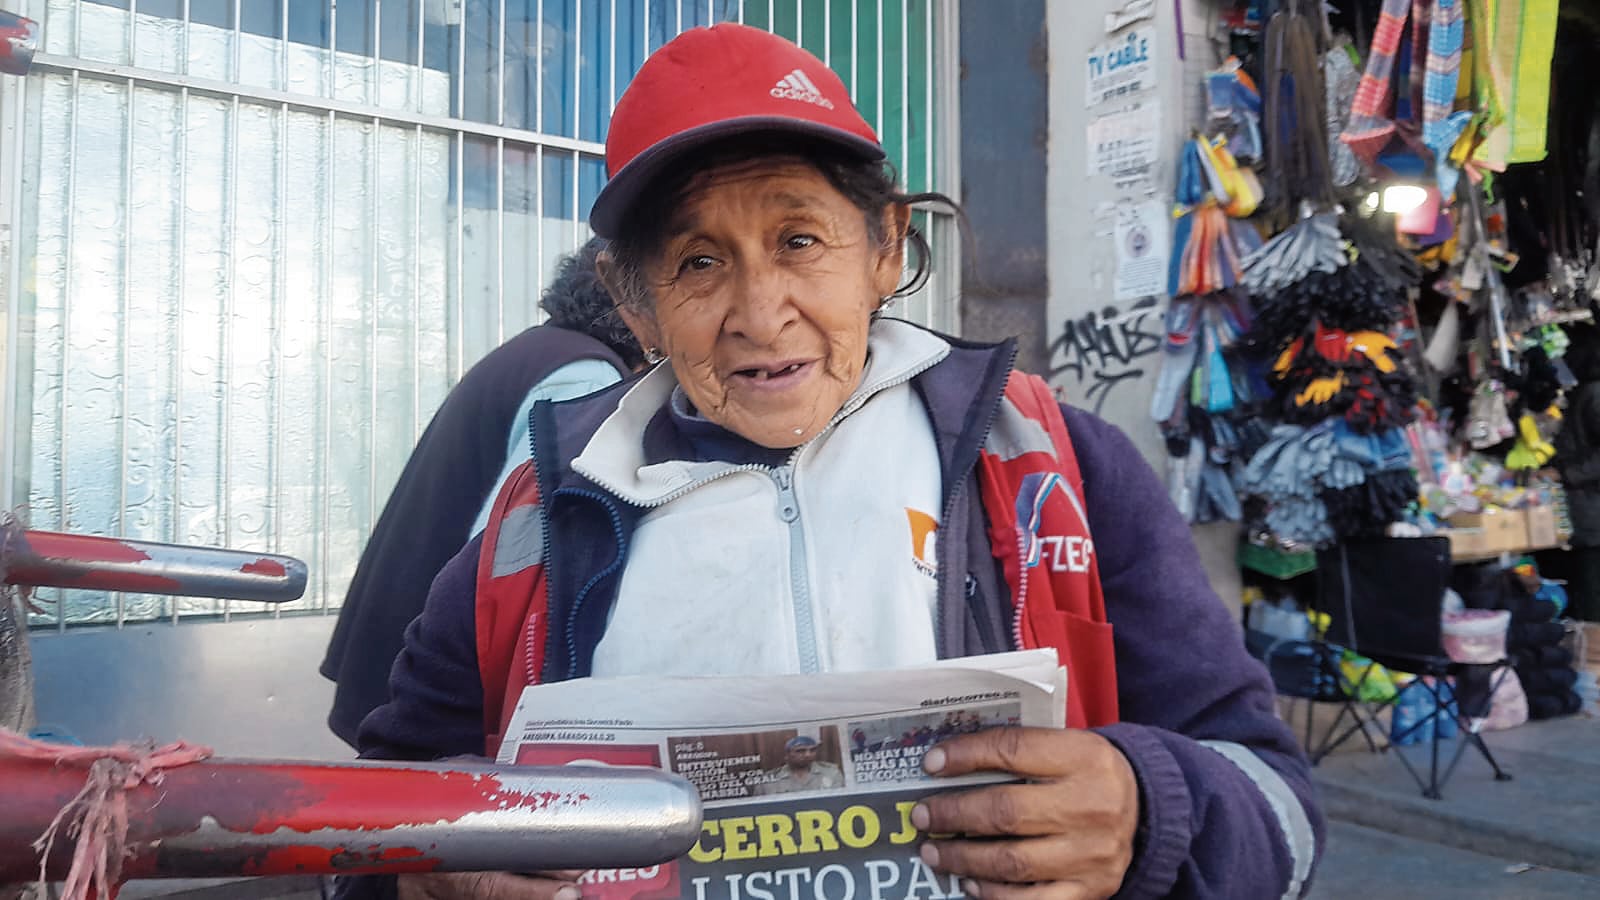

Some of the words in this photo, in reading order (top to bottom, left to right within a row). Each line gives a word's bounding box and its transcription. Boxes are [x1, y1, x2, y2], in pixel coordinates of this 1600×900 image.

[770, 87, 834, 110] adidas
[920, 690, 1021, 708] diariocorreo.pe
[677, 754, 761, 772] INTERVIENEN
[854, 752, 874, 763] NO
[875, 748, 902, 760] HAY
[855, 758, 897, 772] ATRÁS
[899, 759, 908, 769] A
[689, 773, 737, 785] OLICIAL
[739, 768, 764, 779] POR
[720, 779, 743, 788] DEL
[856, 771, 875, 783] EN
[702, 786, 749, 799] NABRIA
[688, 804, 880, 863] CERRO
